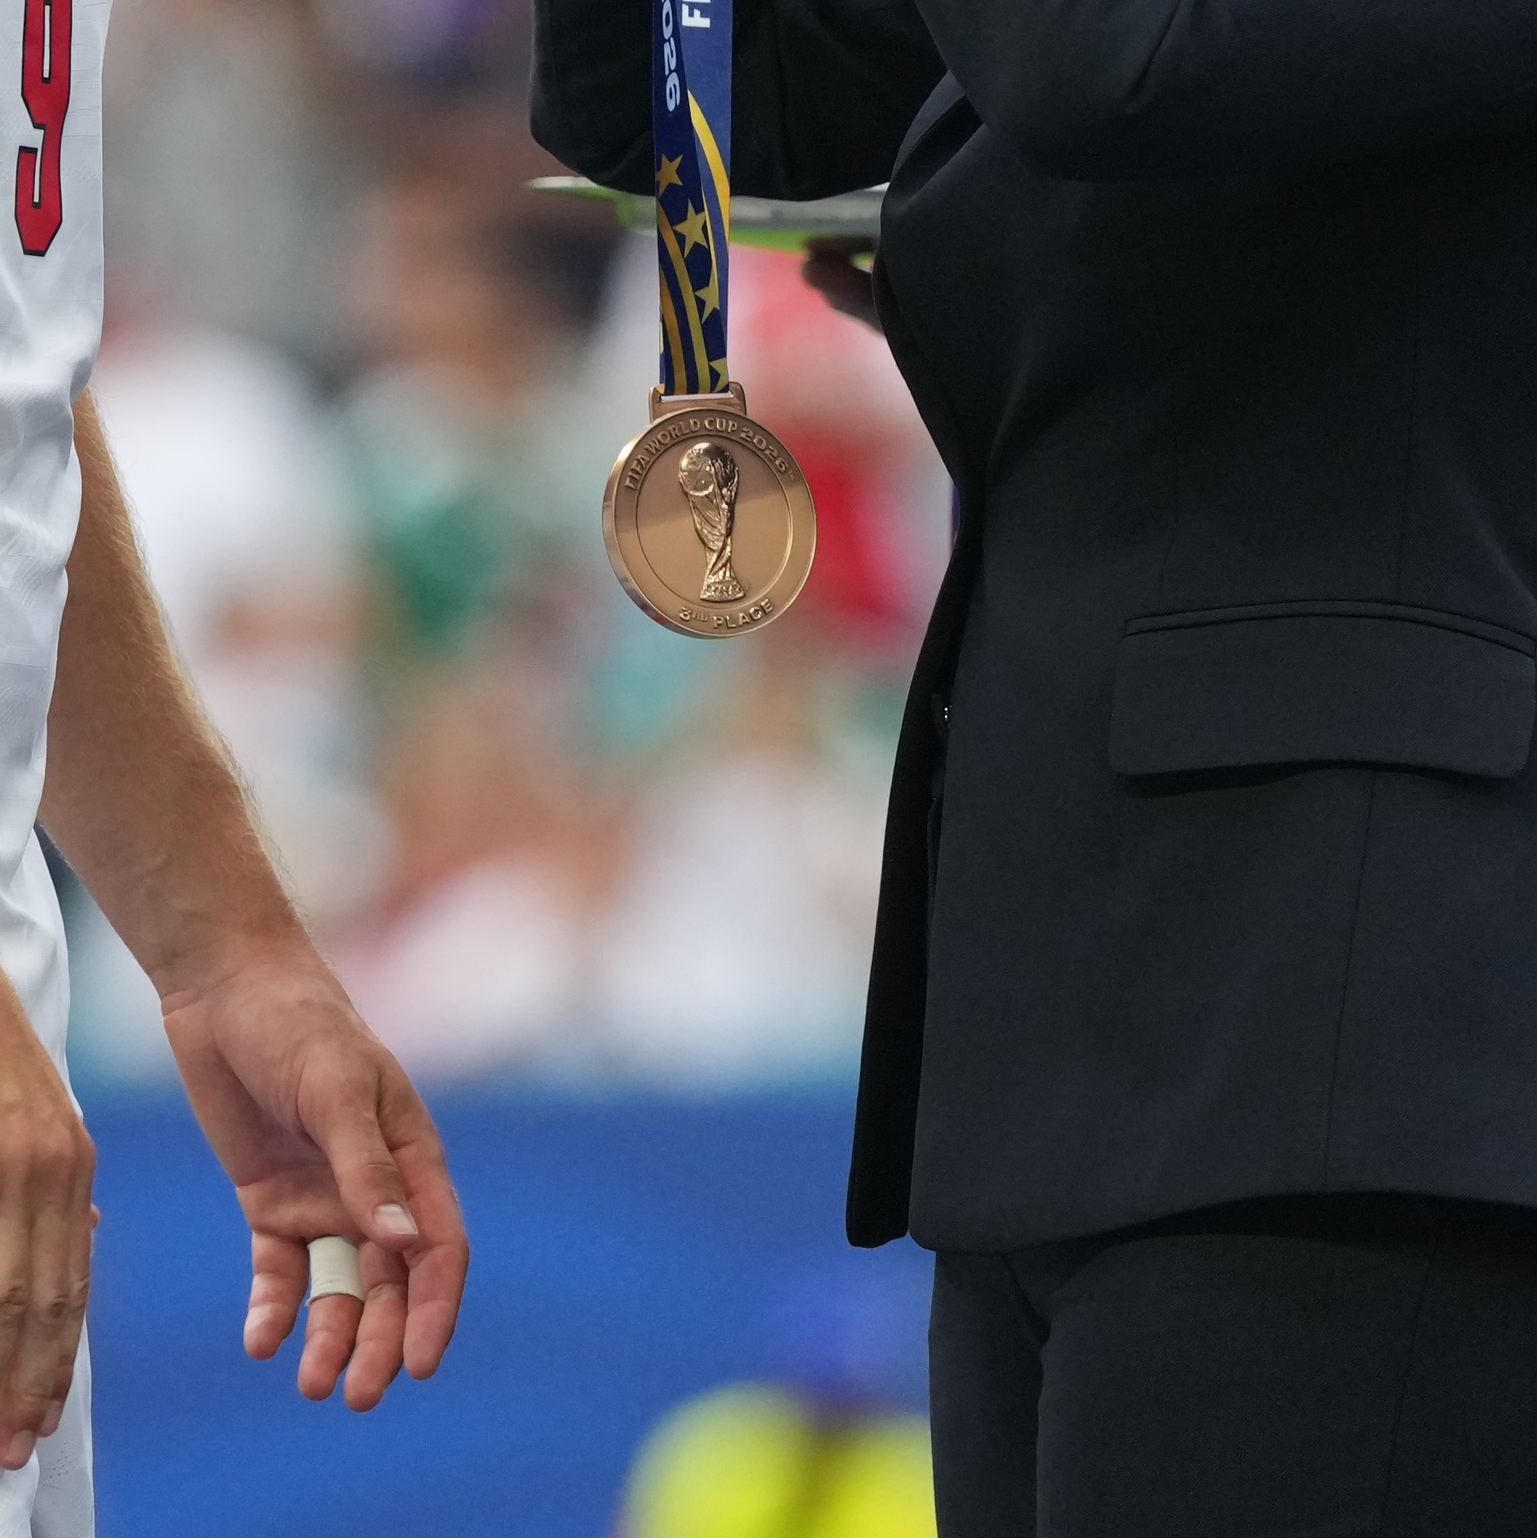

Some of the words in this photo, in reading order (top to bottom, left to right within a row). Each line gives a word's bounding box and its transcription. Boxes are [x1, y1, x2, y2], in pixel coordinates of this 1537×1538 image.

[625, 454, 649, 491] FIFA
[646, 418, 701, 456] WORLD
[703, 417, 738, 433] CUP
[740, 427, 789, 474] 2026
[712, 598, 774, 630] PLACE
